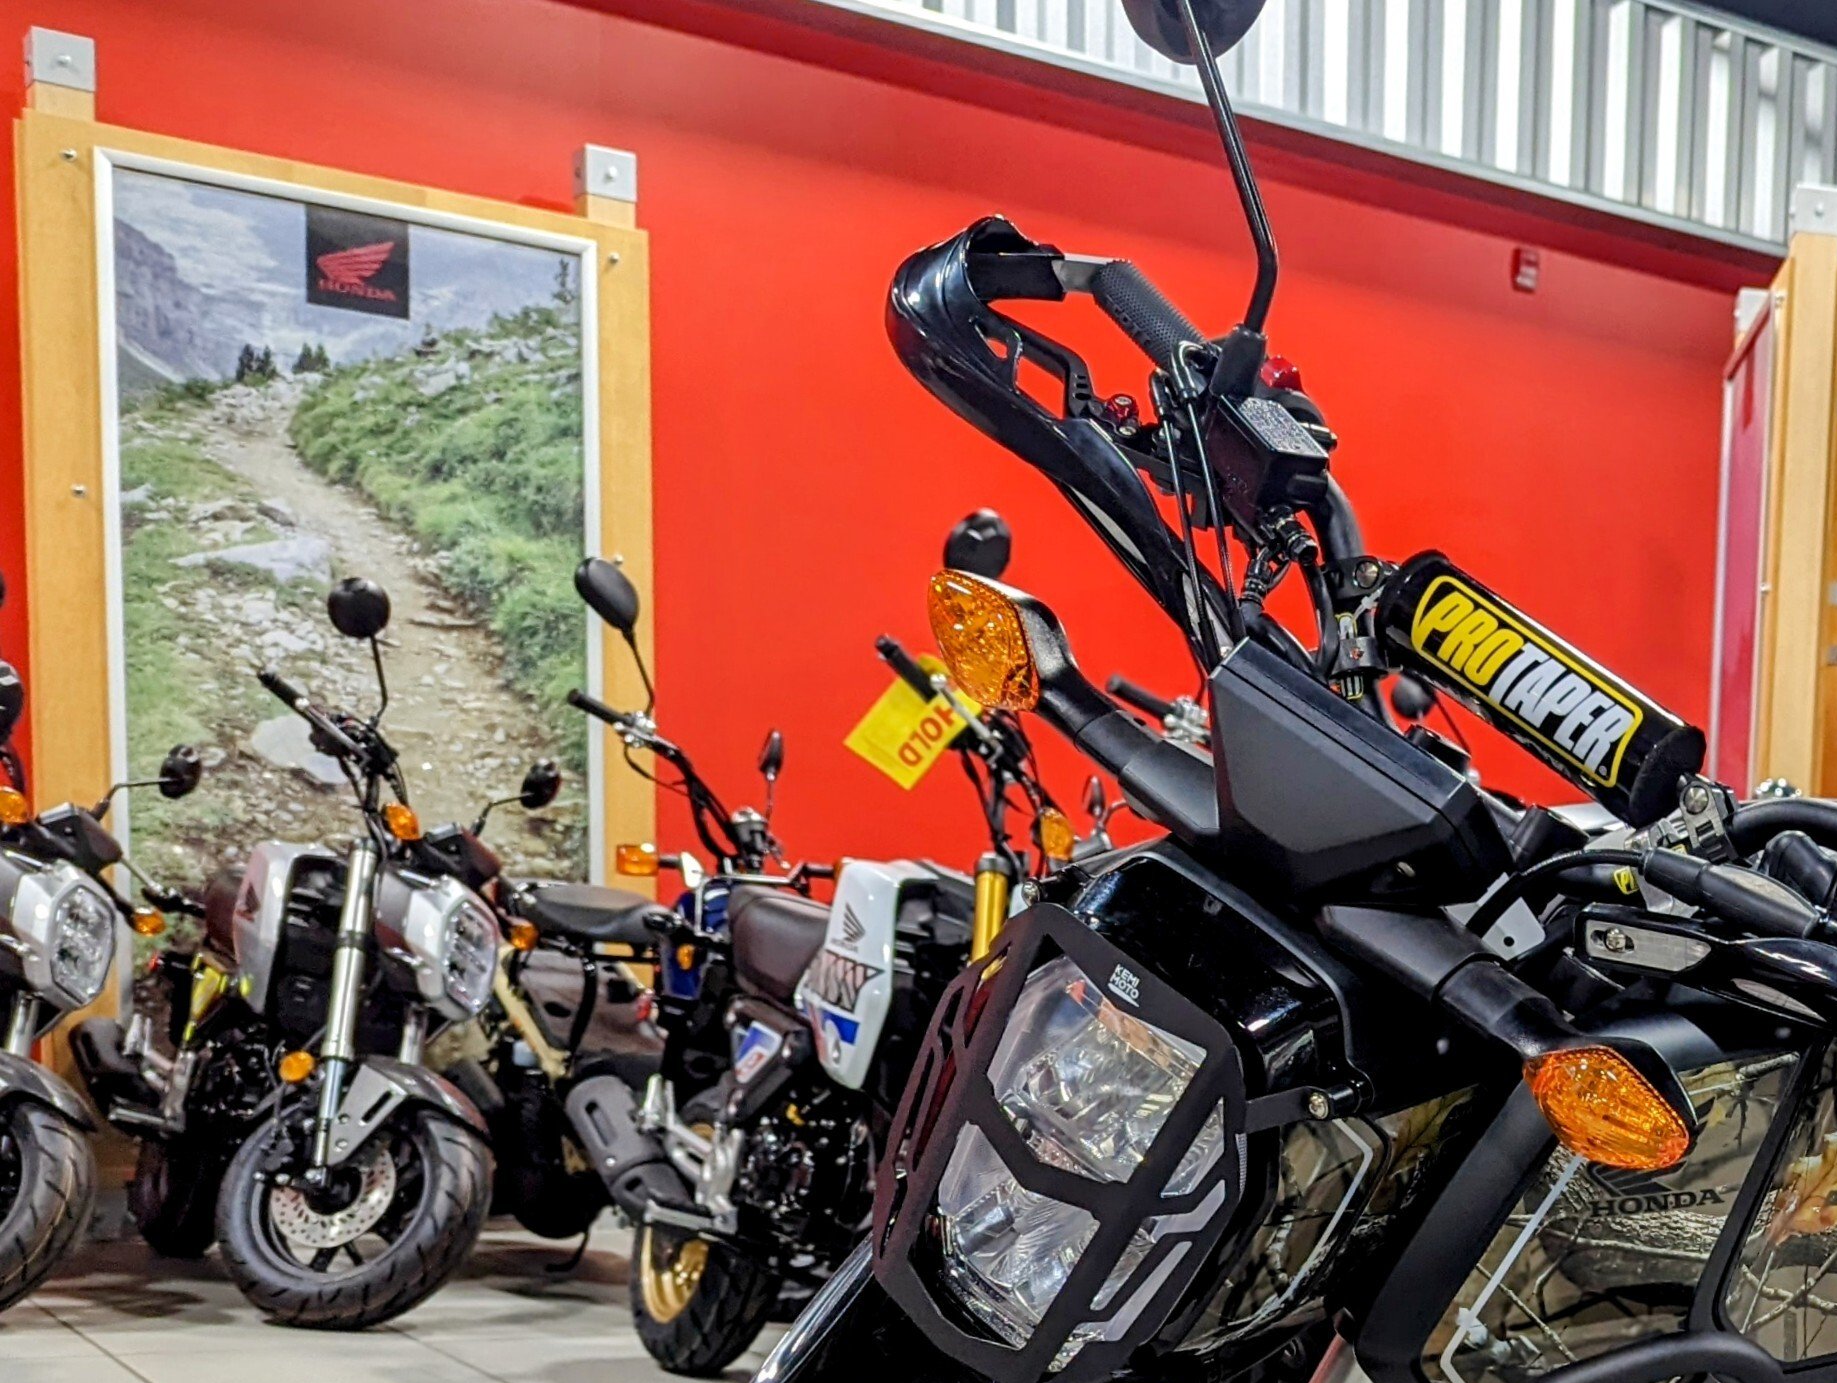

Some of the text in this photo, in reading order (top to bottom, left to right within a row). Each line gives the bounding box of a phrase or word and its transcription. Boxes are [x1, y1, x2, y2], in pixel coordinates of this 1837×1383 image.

[1109, 973, 1139, 999] MOTO
[1114, 963, 1140, 988] KEMI
[1589, 1188, 1725, 1217] HONDA
